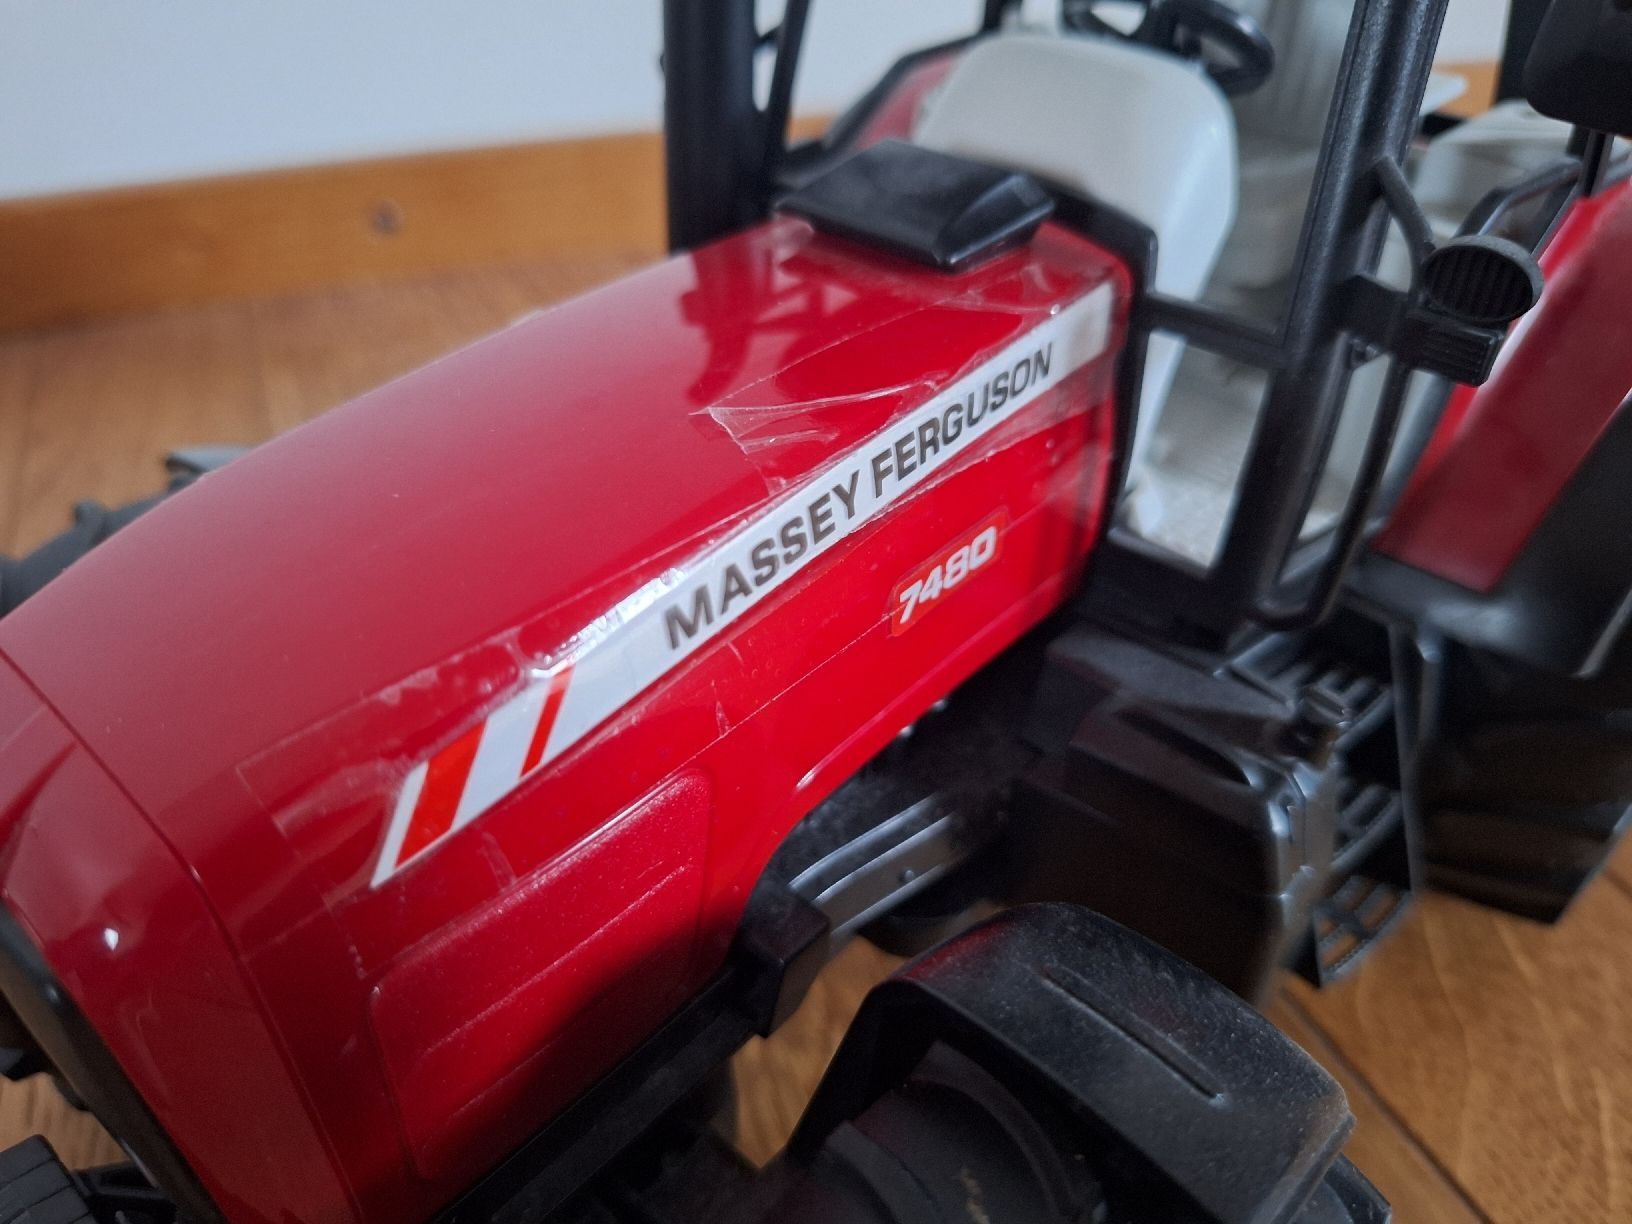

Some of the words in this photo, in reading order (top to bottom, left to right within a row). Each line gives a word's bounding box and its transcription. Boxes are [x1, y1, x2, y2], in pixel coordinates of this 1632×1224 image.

[663, 470, 860, 650] MASSEY
[871, 342, 1054, 499] FERGUSON
[899, 526, 997, 625] 7480
